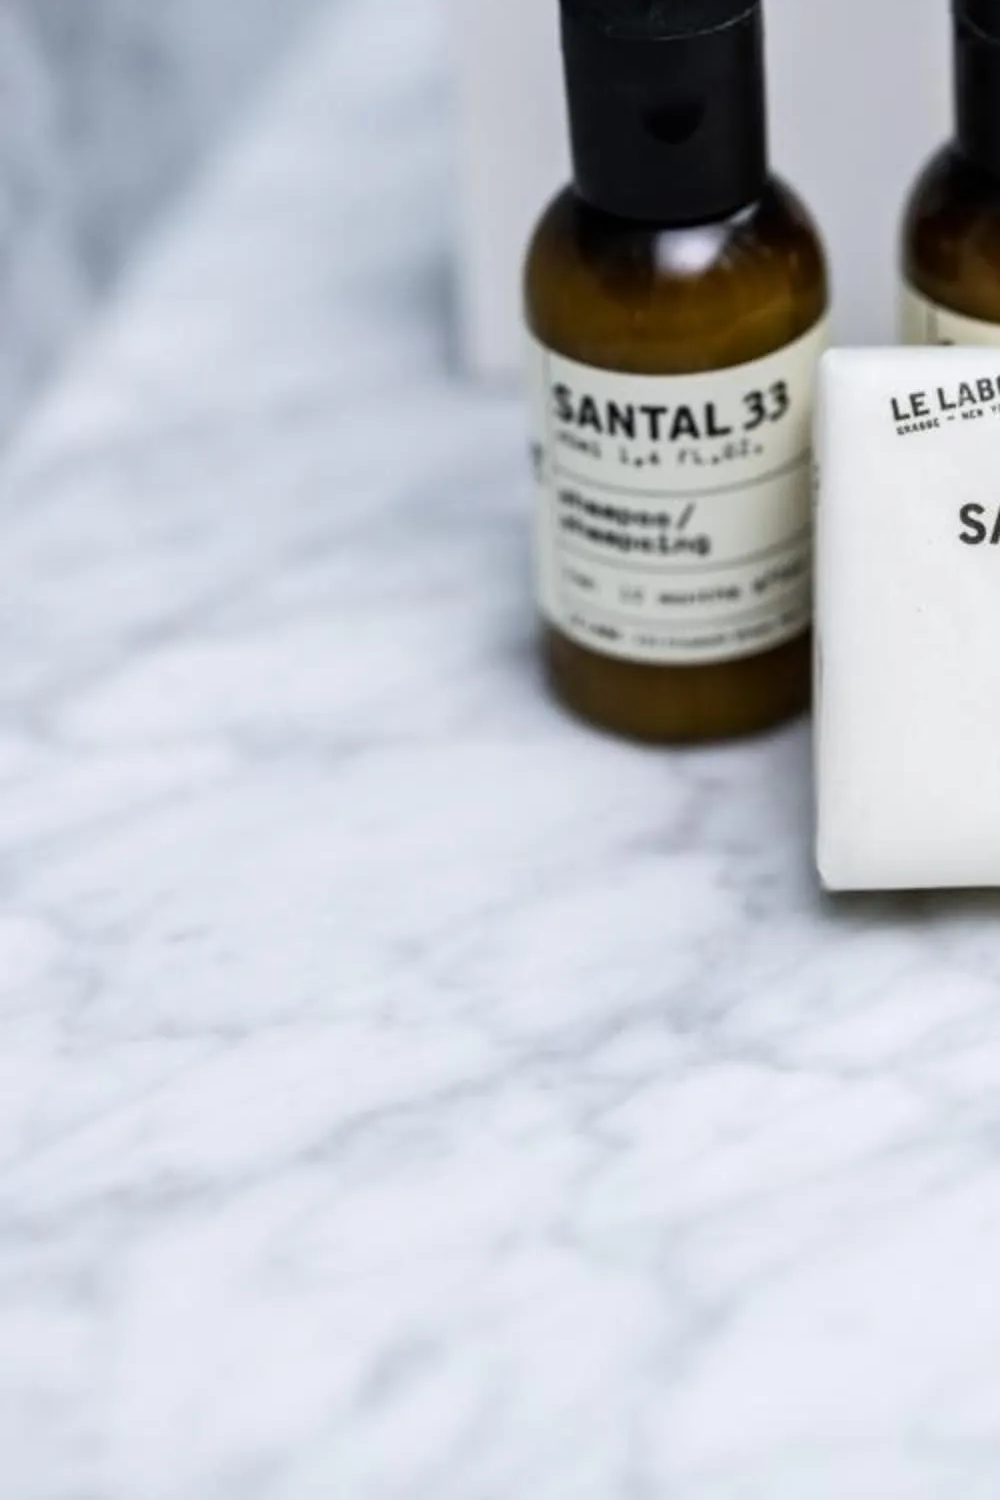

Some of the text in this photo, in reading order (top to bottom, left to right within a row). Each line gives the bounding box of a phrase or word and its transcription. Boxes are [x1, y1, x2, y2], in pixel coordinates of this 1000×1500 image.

[553, 379, 791, 442] SANTAL 33
[890, 392, 931, 422] LE
